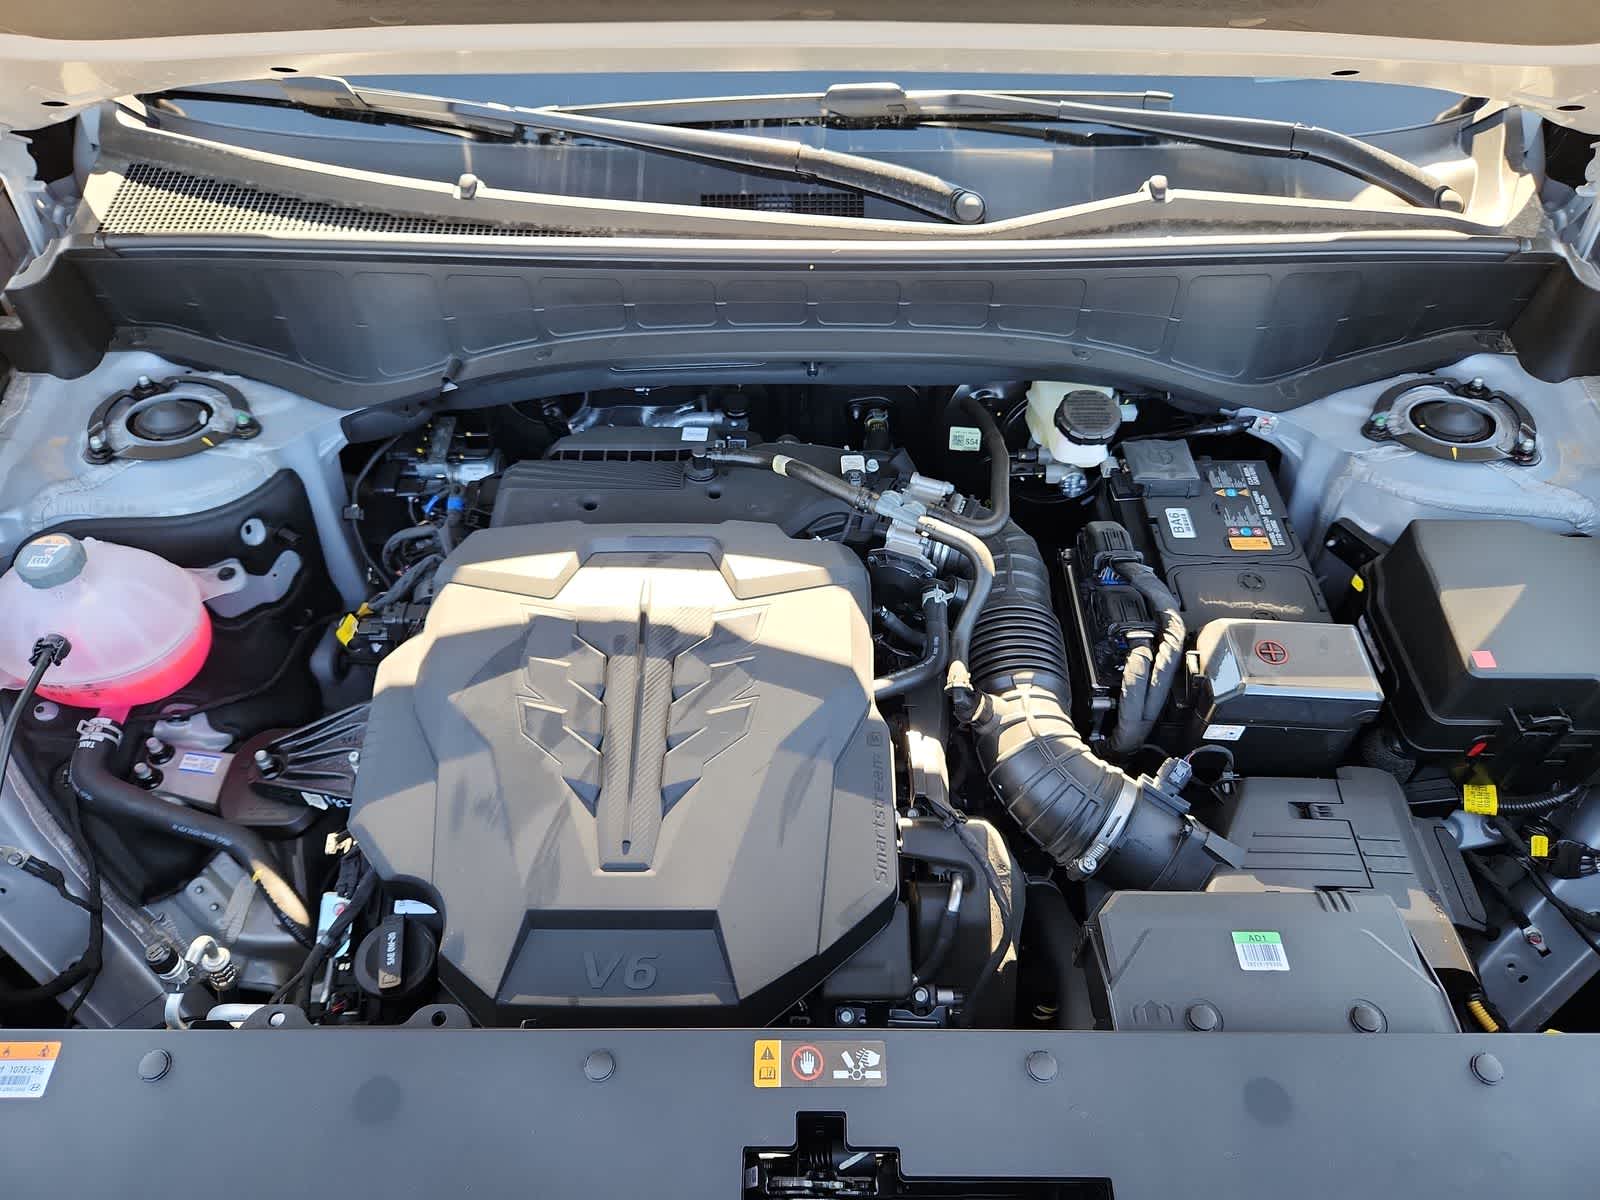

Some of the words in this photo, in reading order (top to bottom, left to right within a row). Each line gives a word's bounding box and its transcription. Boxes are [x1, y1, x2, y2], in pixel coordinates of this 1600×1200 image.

[1168, 512, 1185, 533] BA6
[1248, 934, 1266, 943] AD1
[583, 951, 663, 991] V6
